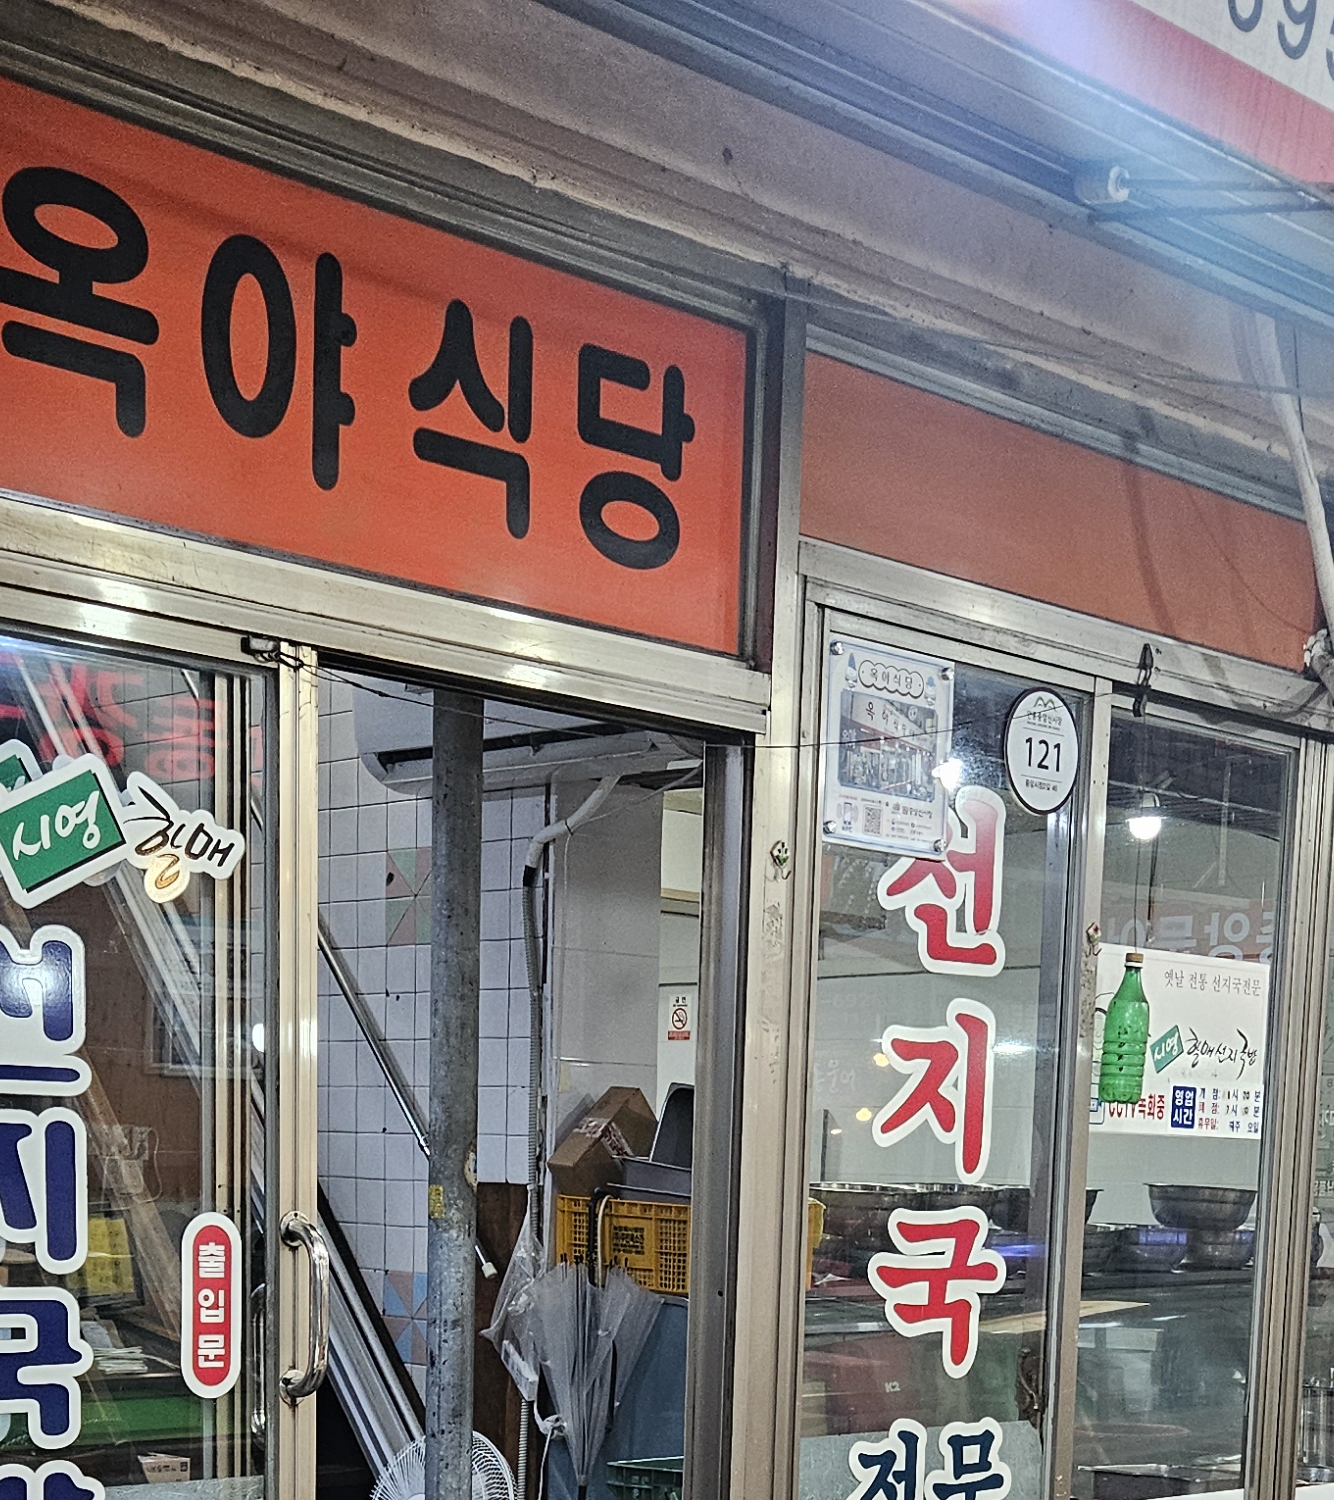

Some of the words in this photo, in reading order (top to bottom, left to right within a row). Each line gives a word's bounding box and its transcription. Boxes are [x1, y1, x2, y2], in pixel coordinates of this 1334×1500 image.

[1026, 737, 1061, 772] 121
[12, 792, 101, 856] 시영
[1165, 969, 1184, 989] 옛날
[1189, 972, 1207, 991] 전통
[1212, 975, 1261, 996] 선지국전문
[876, 802, 999, 1366] 선지국
[1174, 1089, 1194, 1106] 영업
[1173, 1109, 1194, 1125] 시간
[198, 1242, 225, 1369] 출입문
